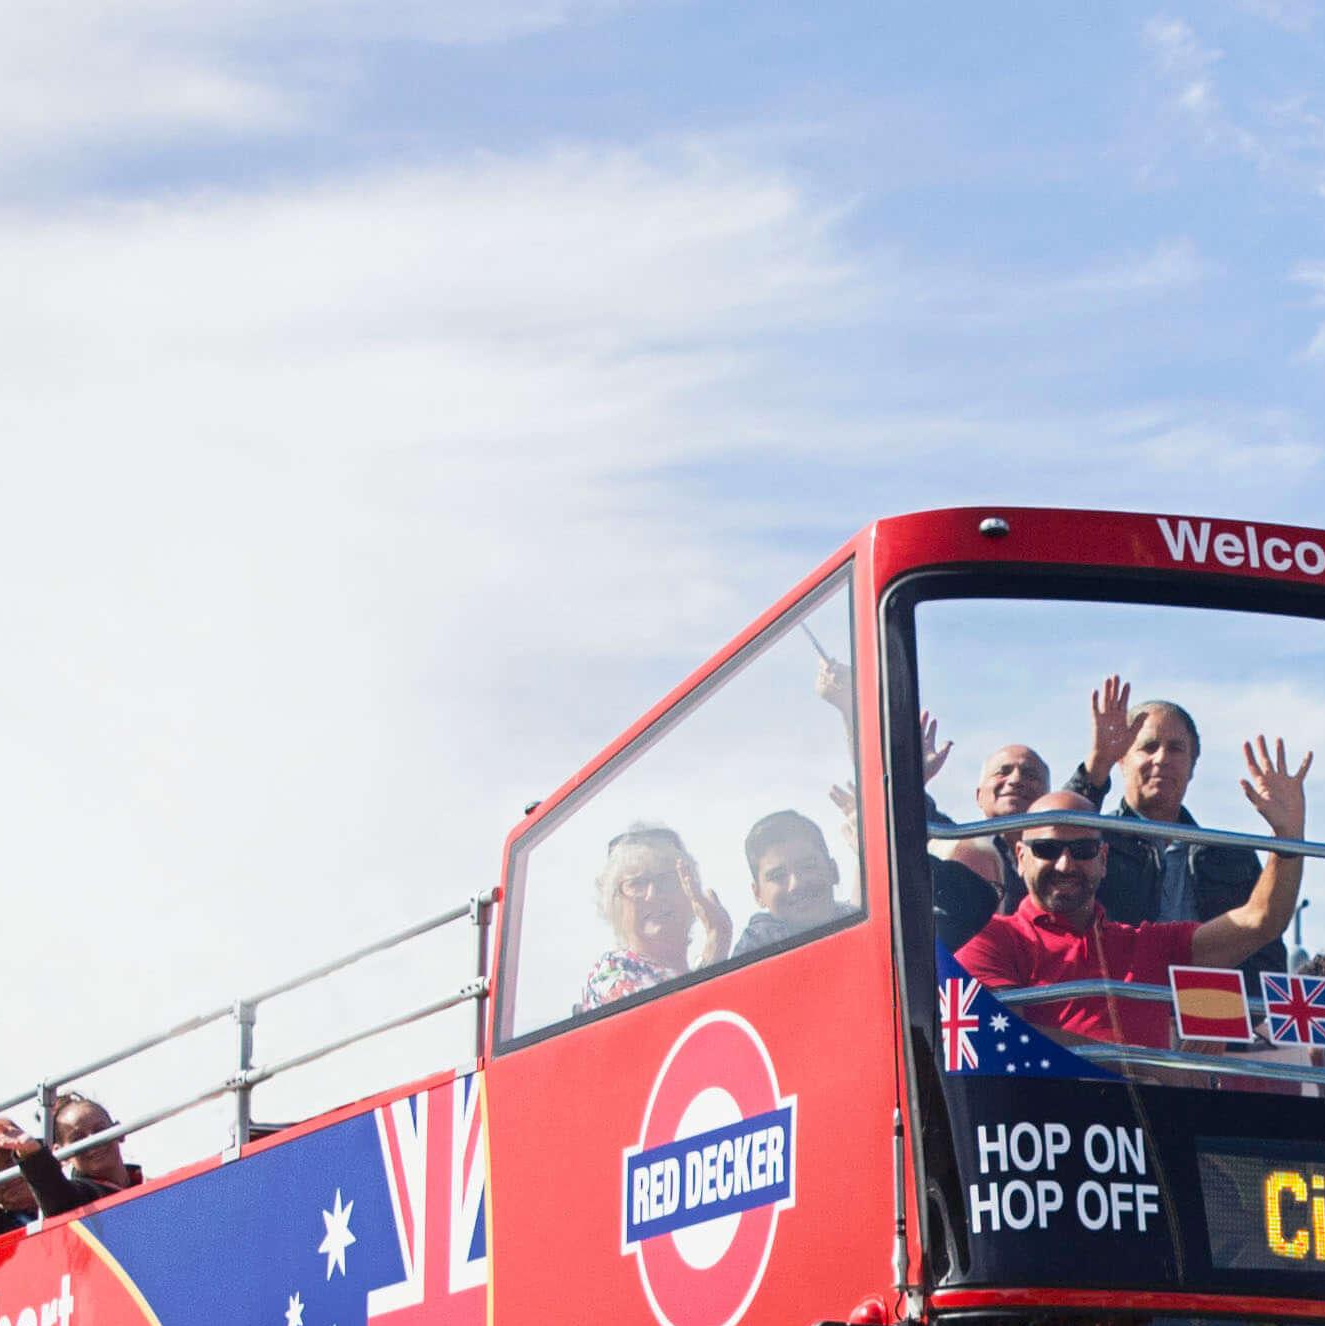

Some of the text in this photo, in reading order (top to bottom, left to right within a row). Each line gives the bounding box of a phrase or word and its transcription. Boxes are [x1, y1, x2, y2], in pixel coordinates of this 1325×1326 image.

[633, 1126, 784, 1225] RED DECKER
[977, 1122, 1146, 1175] HOP ON
[970, 1180, 1159, 1234] HOP OFF
